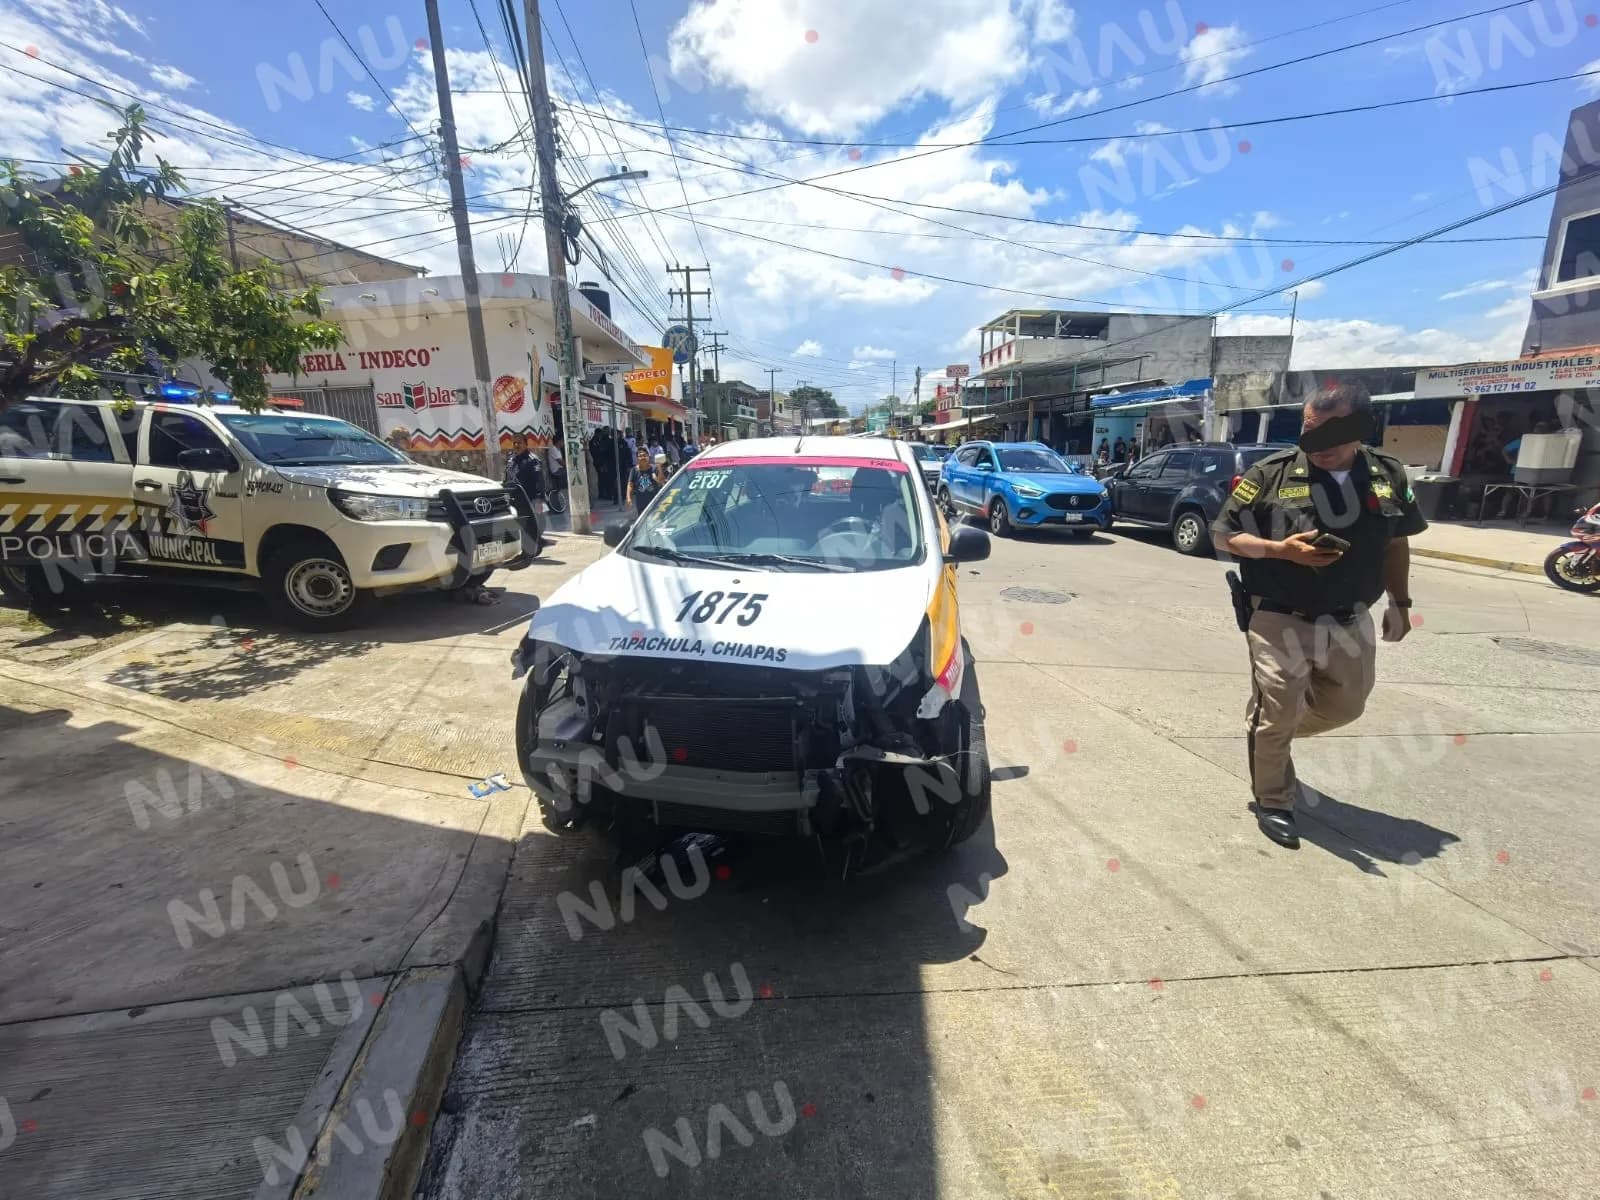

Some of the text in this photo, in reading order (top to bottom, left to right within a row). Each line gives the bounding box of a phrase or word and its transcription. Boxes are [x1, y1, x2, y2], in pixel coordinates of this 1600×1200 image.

[1428, 356, 1593, 380] MULTISERVICIOS INDUSTRIALES
[376, 391, 403, 406] san
[1475, 381, 1537, 393] 962 127 14 02
[150, 534, 223, 565] MUNICIPAL
[674, 590, 769, 627] 1875
[608, 636, 788, 662] TAPACHULA, CHIAPAS
